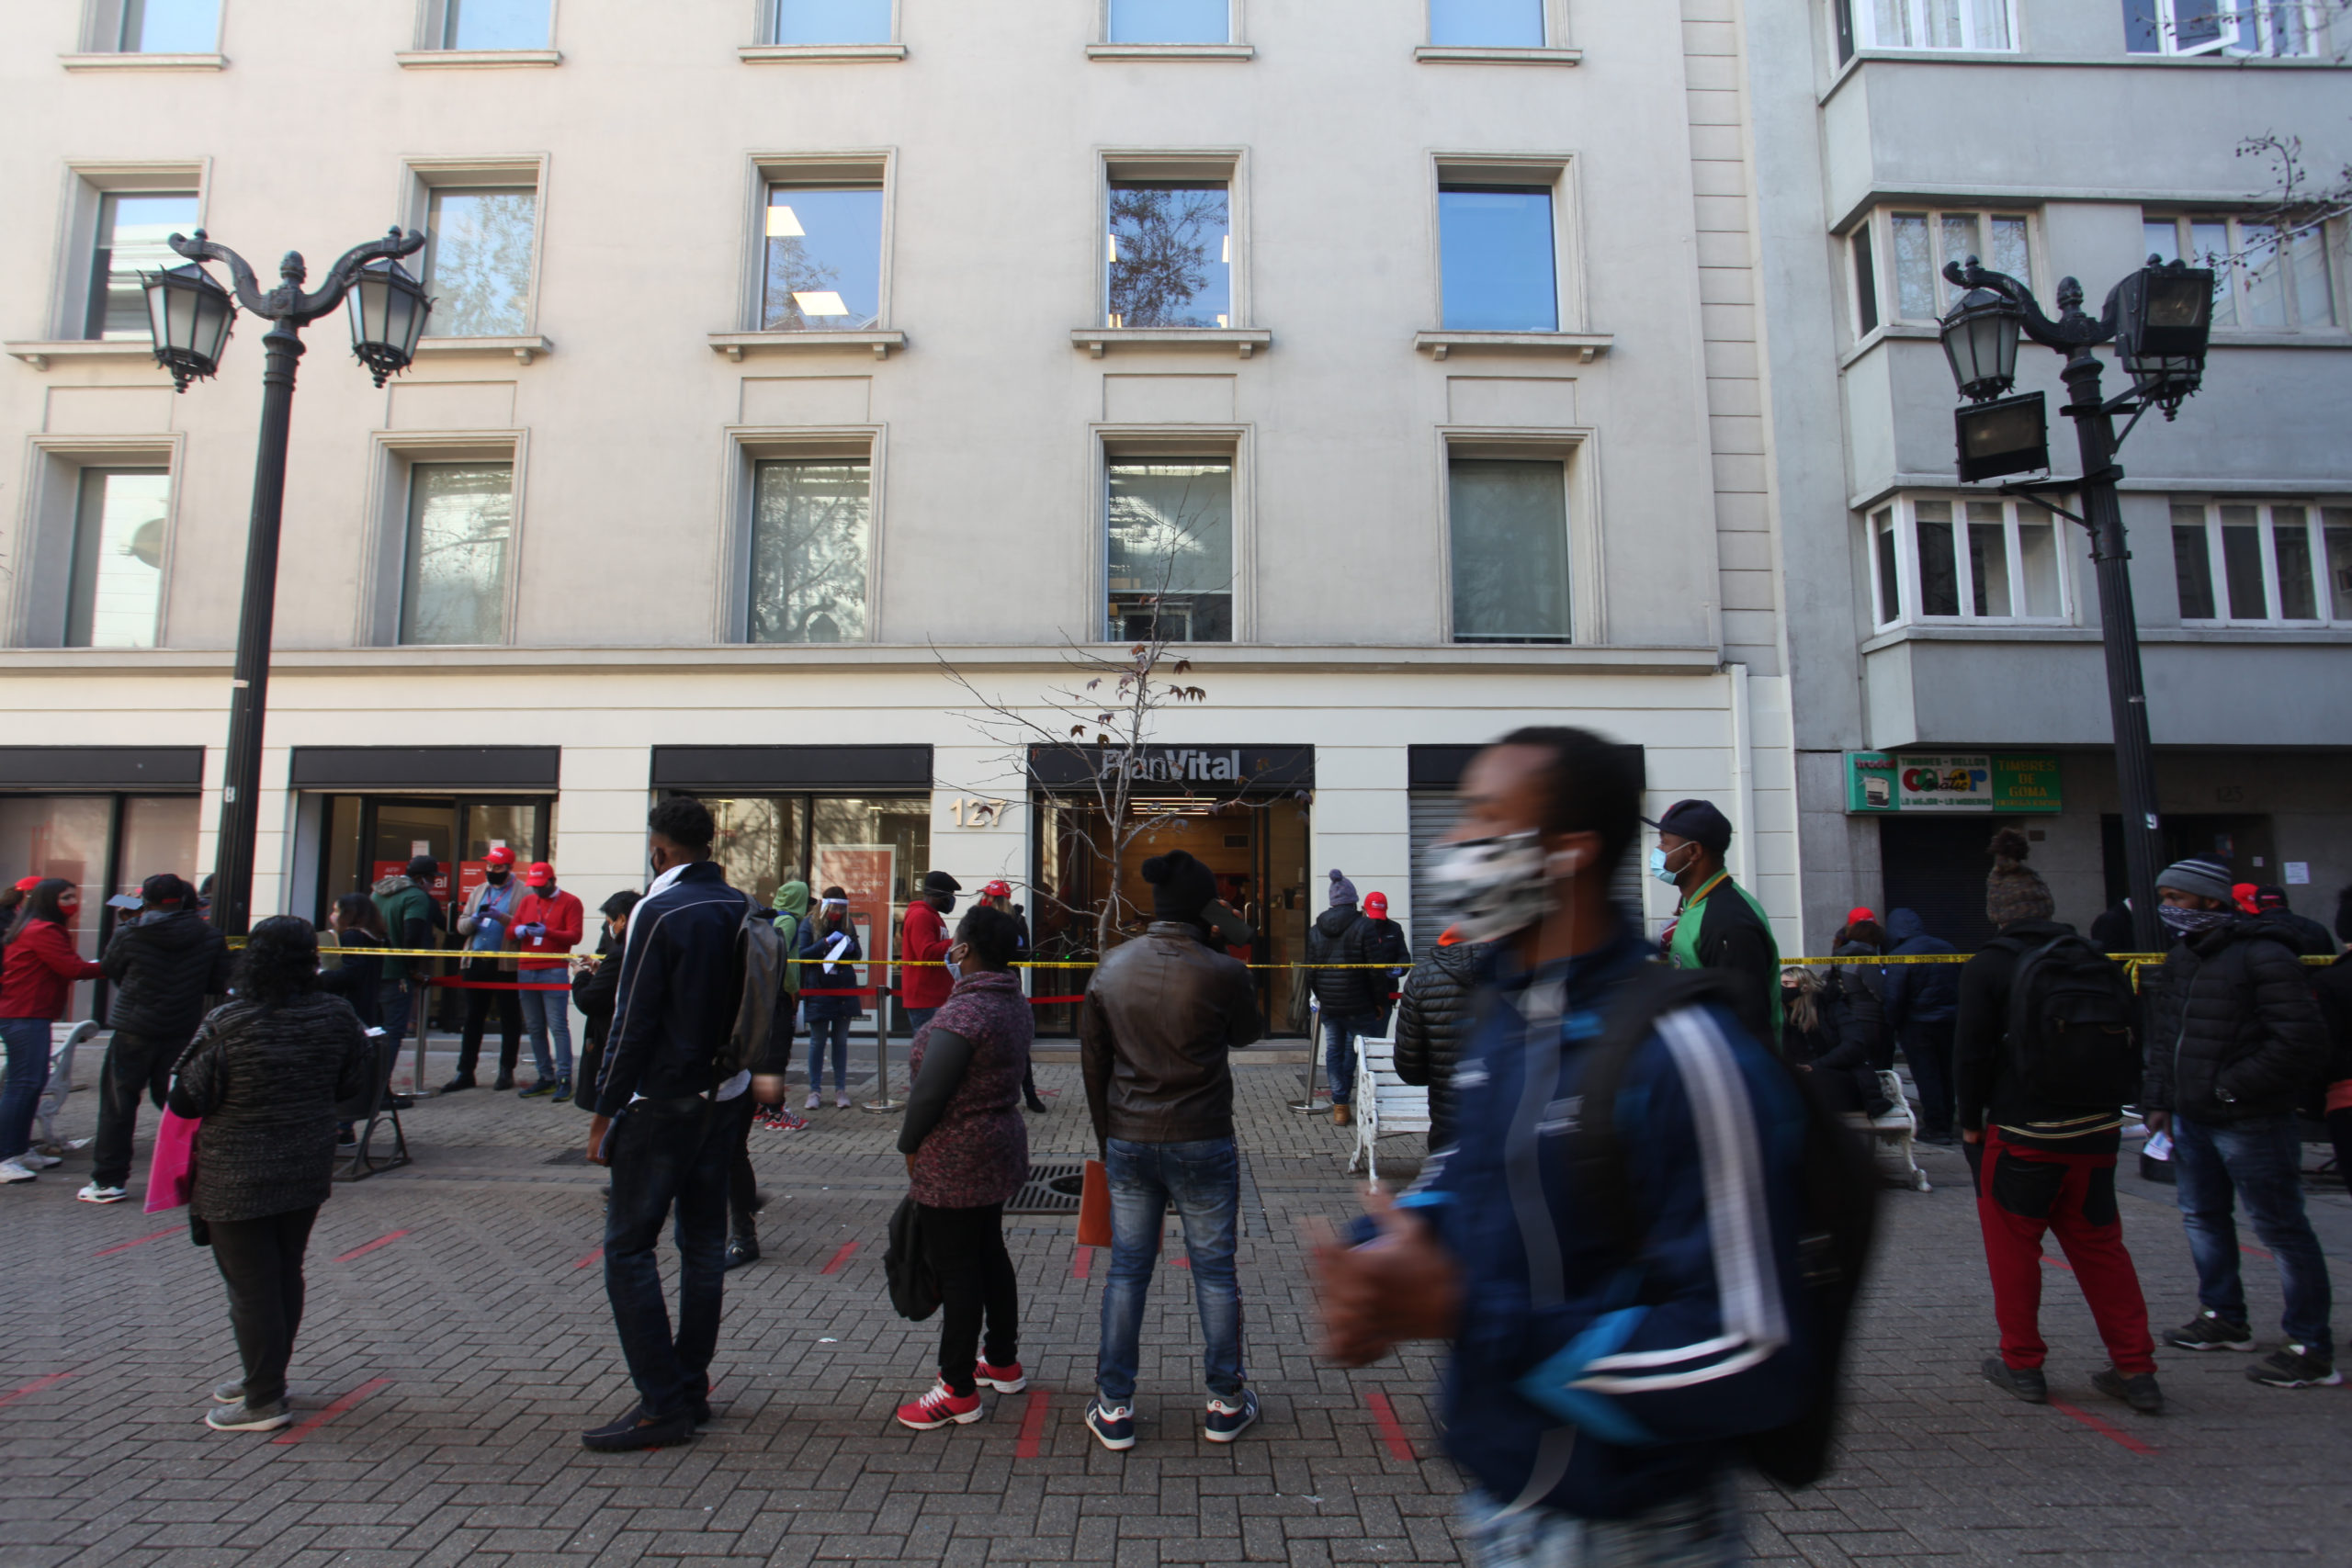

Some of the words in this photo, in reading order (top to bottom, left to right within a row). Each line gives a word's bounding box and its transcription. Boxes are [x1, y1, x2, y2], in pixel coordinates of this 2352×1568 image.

[1103, 749, 1240, 781] PlanVital
[1996, 759, 2056, 772] TIMBRES
[2018, 773, 2036, 784] DE
[224, 786, 236, 803] 8
[2009, 785, 2048, 797] GOMA
[949, 797, 1008, 827] 127
[2145, 811, 2158, 829] 9
